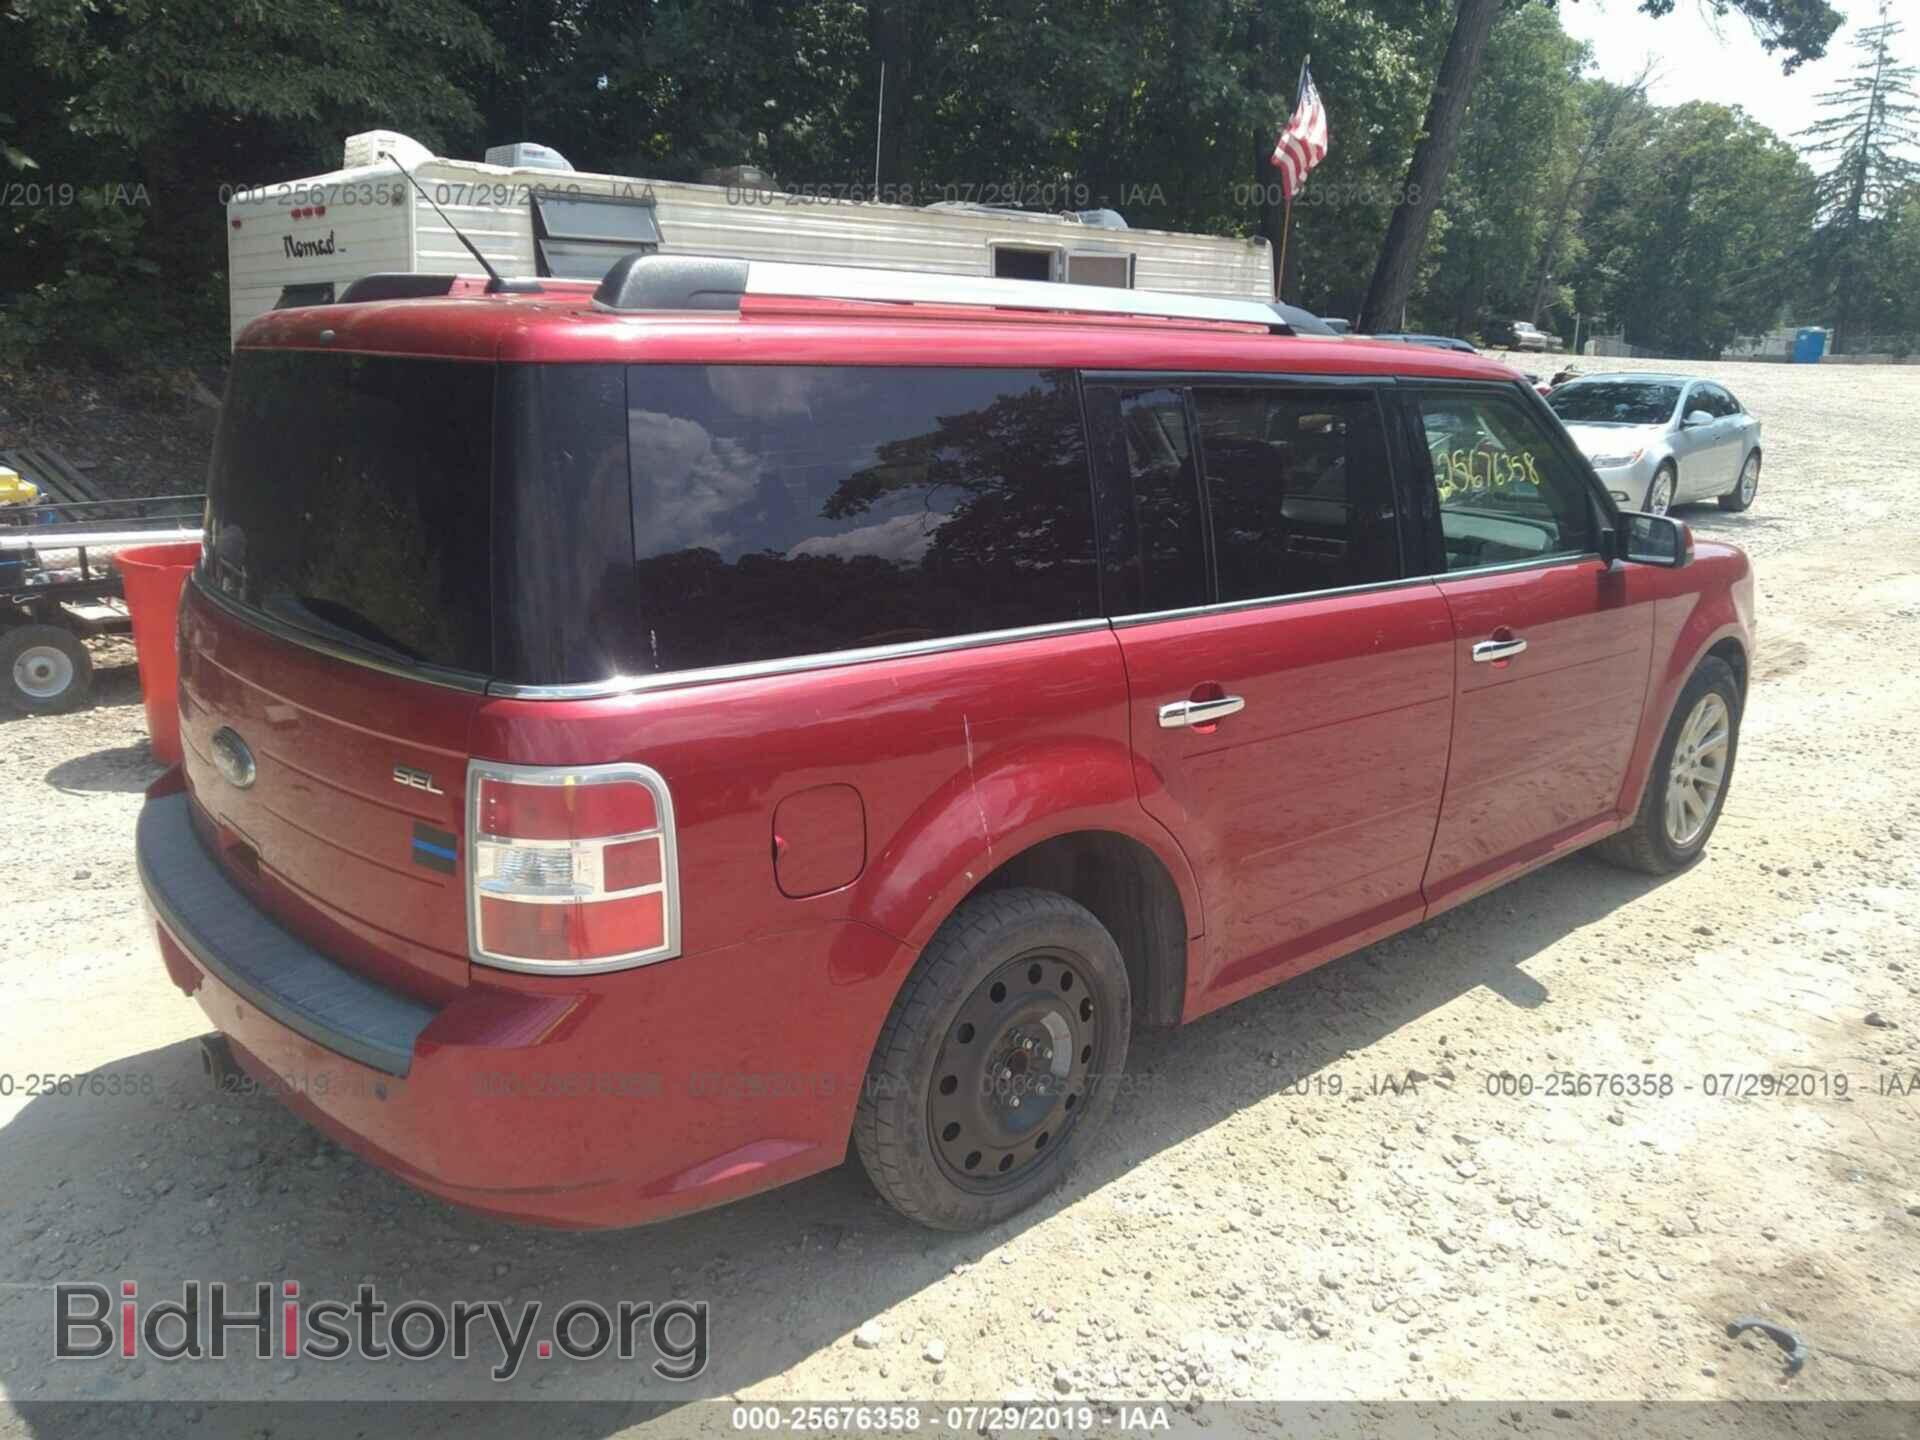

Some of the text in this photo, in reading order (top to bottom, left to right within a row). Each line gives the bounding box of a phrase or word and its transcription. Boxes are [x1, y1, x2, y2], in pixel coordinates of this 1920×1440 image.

[282, 228, 336, 259] Nomad
[1436, 449, 1540, 492] 25676358
[392, 766, 445, 796] SEL
